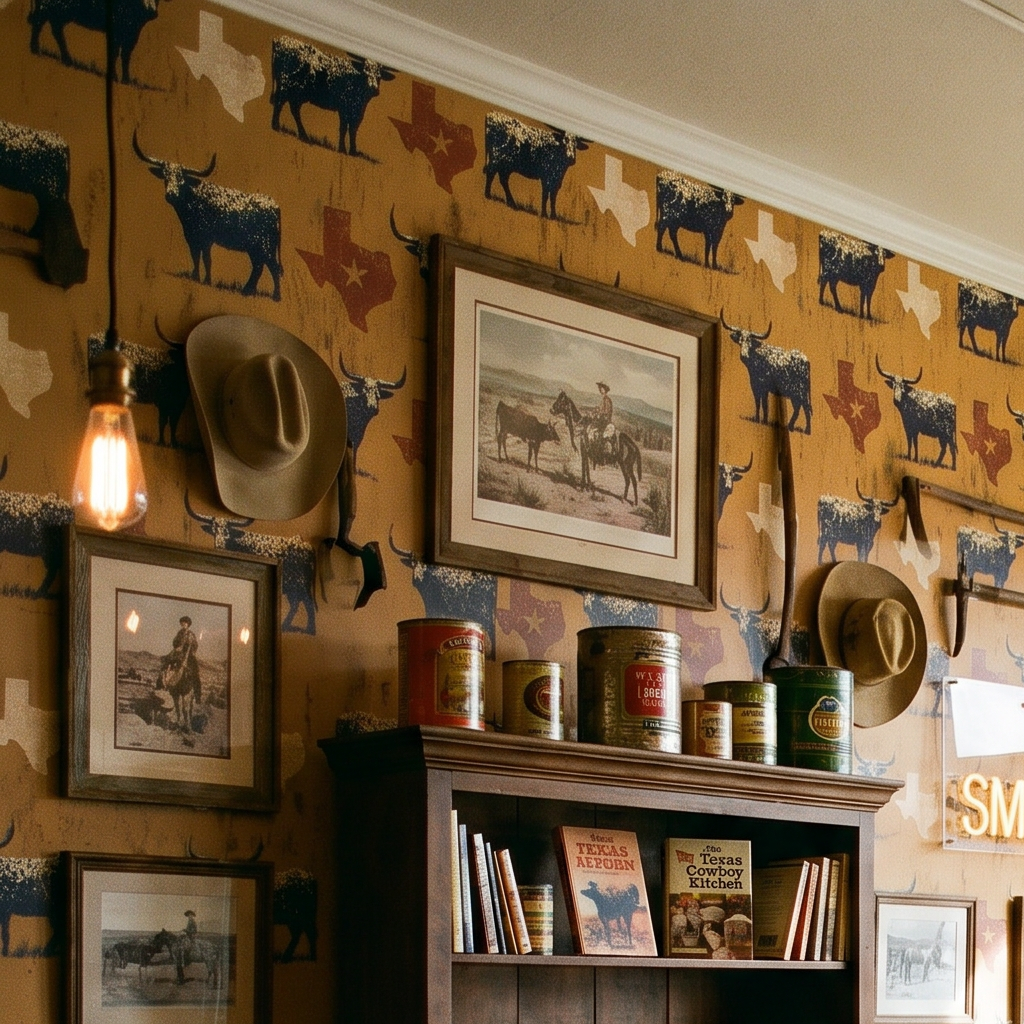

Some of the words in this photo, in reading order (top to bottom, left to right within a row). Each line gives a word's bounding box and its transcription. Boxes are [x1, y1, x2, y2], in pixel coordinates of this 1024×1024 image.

[700, 853, 742, 866] Texas
[686, 865, 744, 881] Cowboy
[689, 877, 743, 889] Kitchen
